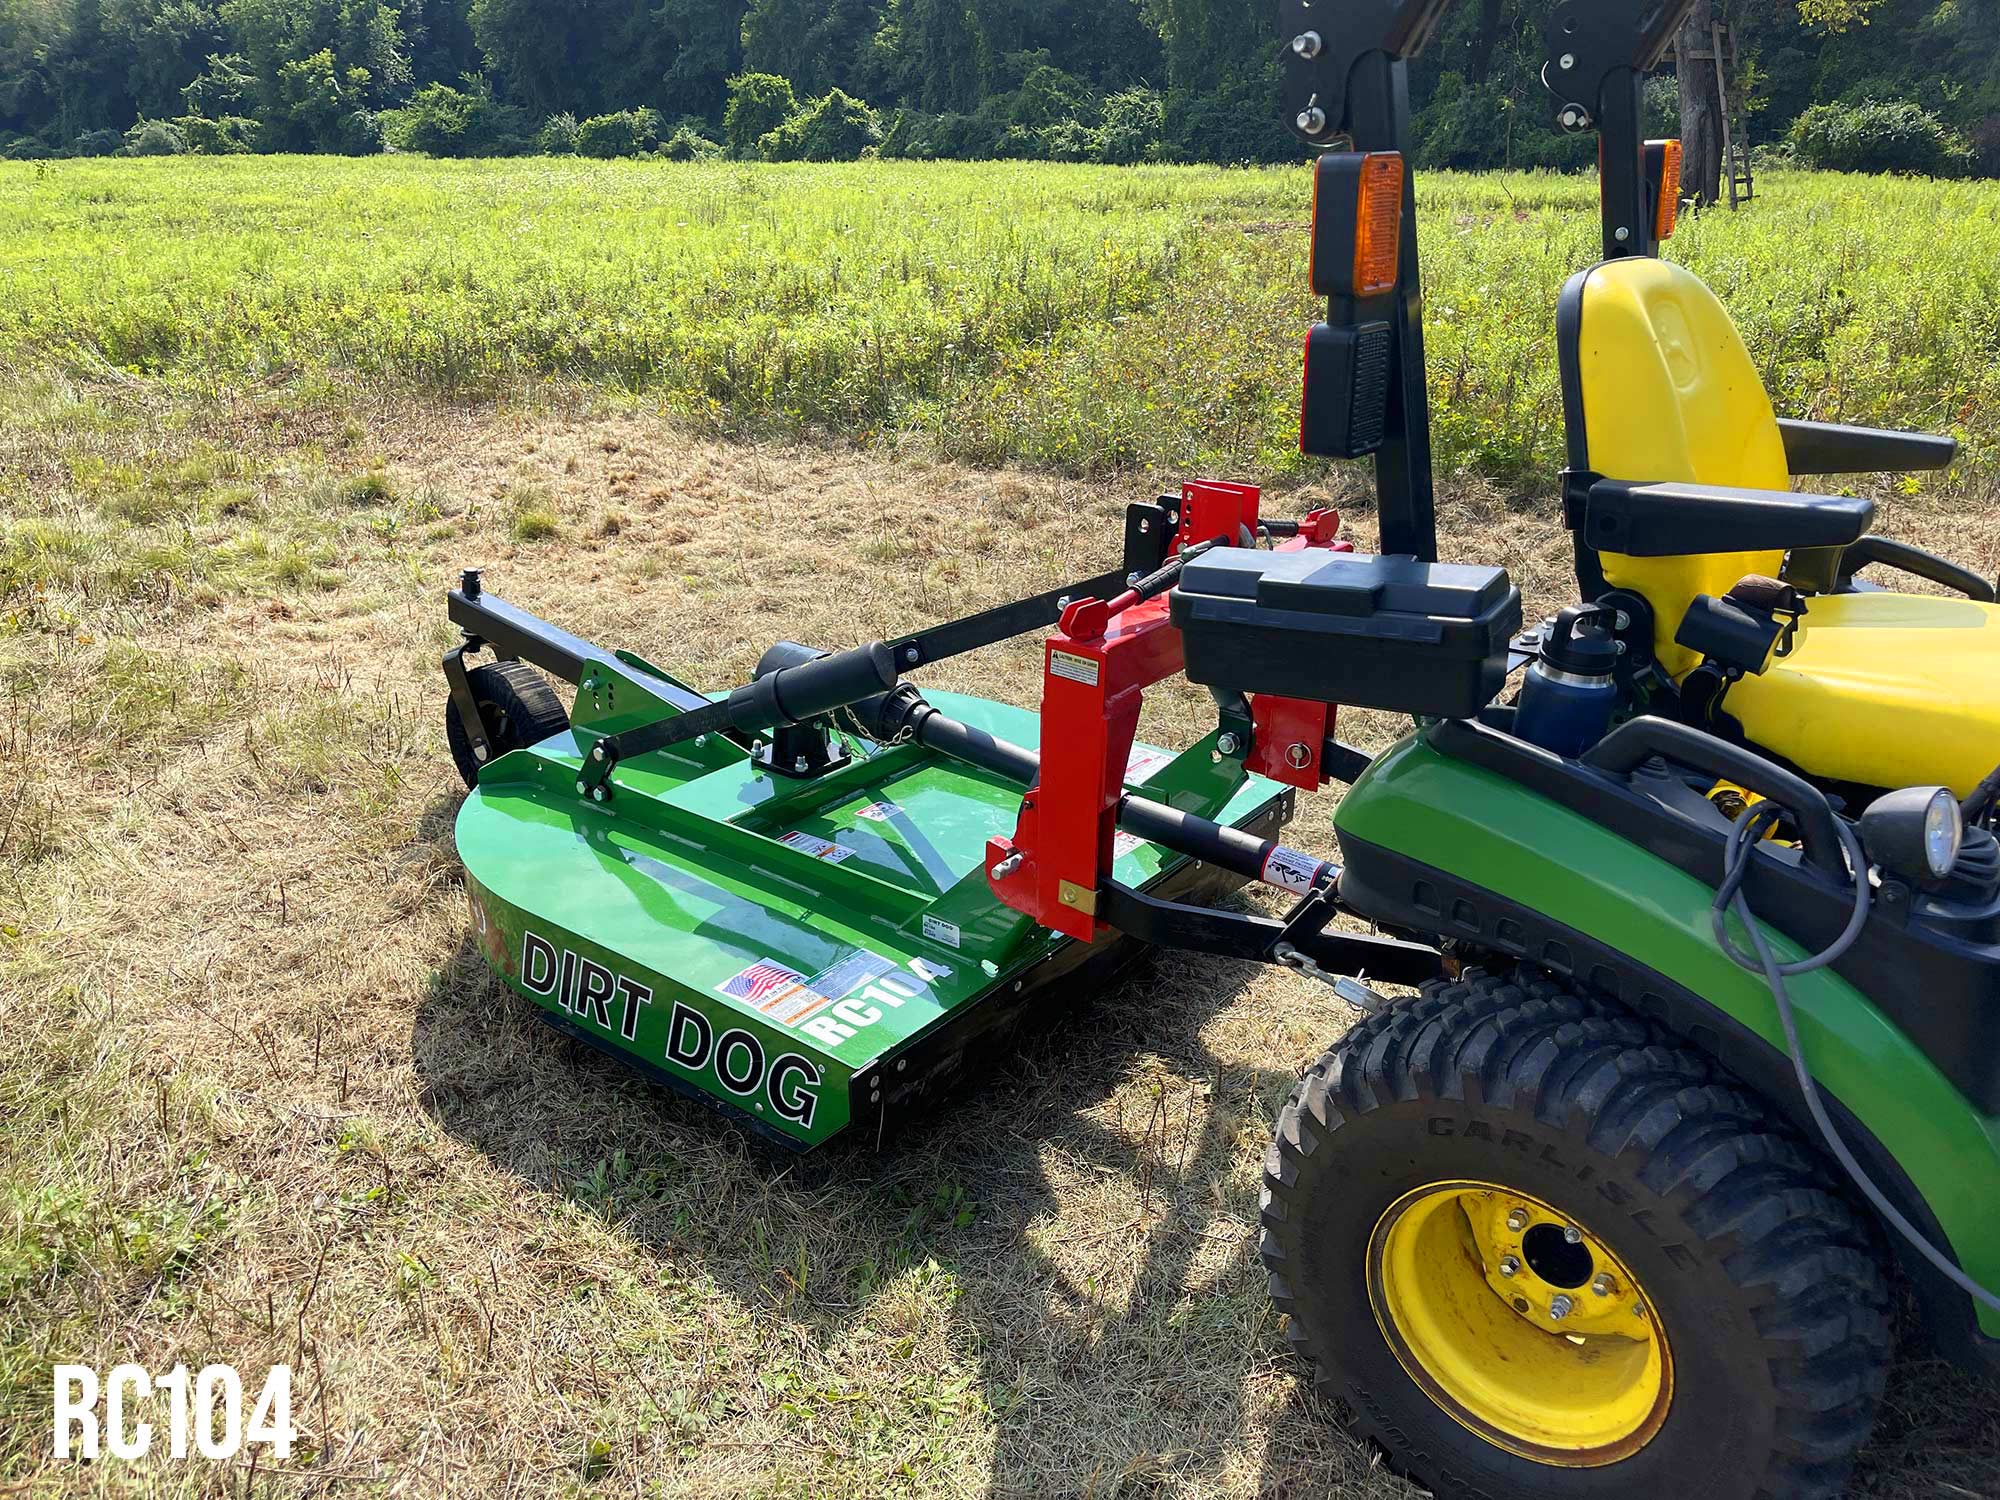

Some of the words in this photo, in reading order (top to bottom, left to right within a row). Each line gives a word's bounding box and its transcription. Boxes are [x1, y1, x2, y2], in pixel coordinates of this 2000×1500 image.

[521, 930, 652, 1041] DIRT
[665, 1000, 822, 1129] DOG
[799, 956, 954, 1047] RC104
[1427, 1116, 1700, 1271] CARLISLE
